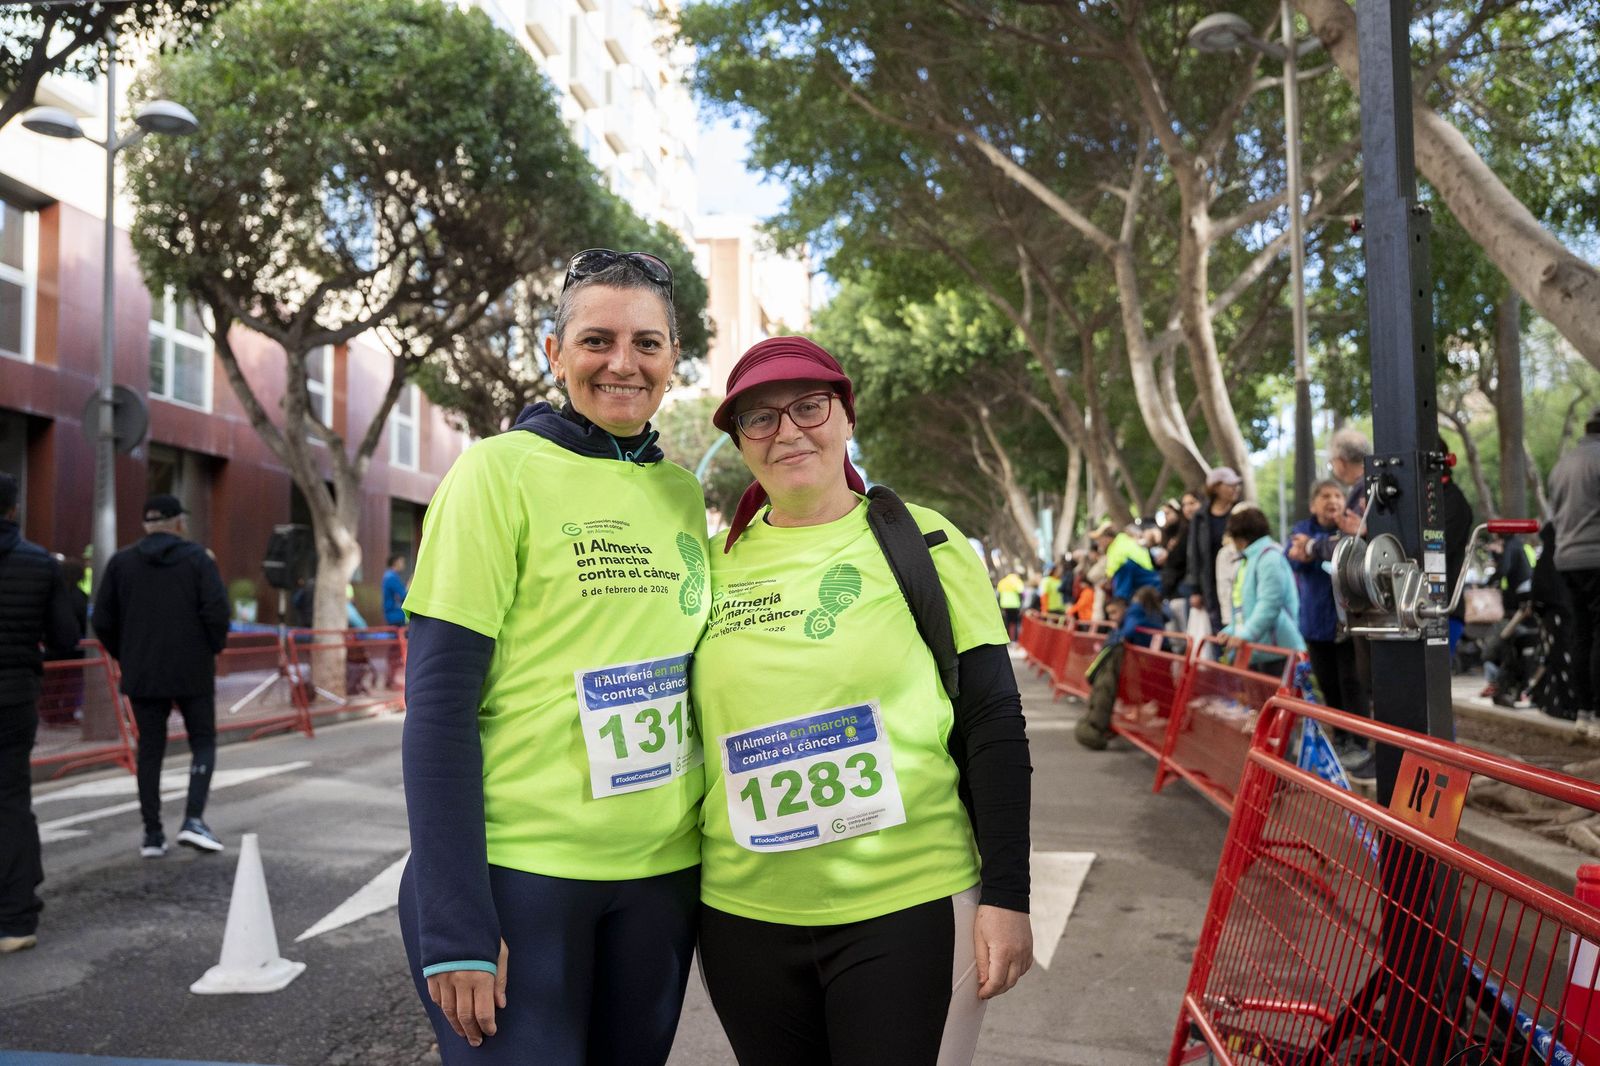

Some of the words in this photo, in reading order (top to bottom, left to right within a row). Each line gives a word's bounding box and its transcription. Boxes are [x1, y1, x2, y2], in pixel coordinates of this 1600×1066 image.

[573, 542, 586, 556] II
[590, 538, 653, 555] Almería
[577, 557, 596, 567] en
[599, 555, 650, 565] marcha
[578, 568, 626, 582] contra
[629, 568, 642, 578] el
[644, 567, 680, 581] cáncer
[581, 589, 588, 597] 8
[591, 587, 602, 595] de
[605, 585, 636, 594] febrero
[638, 585, 648, 593] de
[650, 585, 669, 594] 2026
[721, 592, 781, 612] Almería
[744, 613, 756, 626] el
[759, 608, 806, 623] cáncer
[604, 669, 653, 686] Almería
[654, 667, 667, 678] en
[601, 686, 644, 702] contra
[648, 683, 658, 693] el
[734, 742, 741, 752] II
[743, 730, 787, 751] Almería
[789, 728, 806, 738] en
[807, 714, 858, 733] marcha
[742, 749, 779, 765] contra
[782, 742, 794, 755] el
[797, 733, 841, 752] cáncer
[740, 752, 883, 822] 1283
